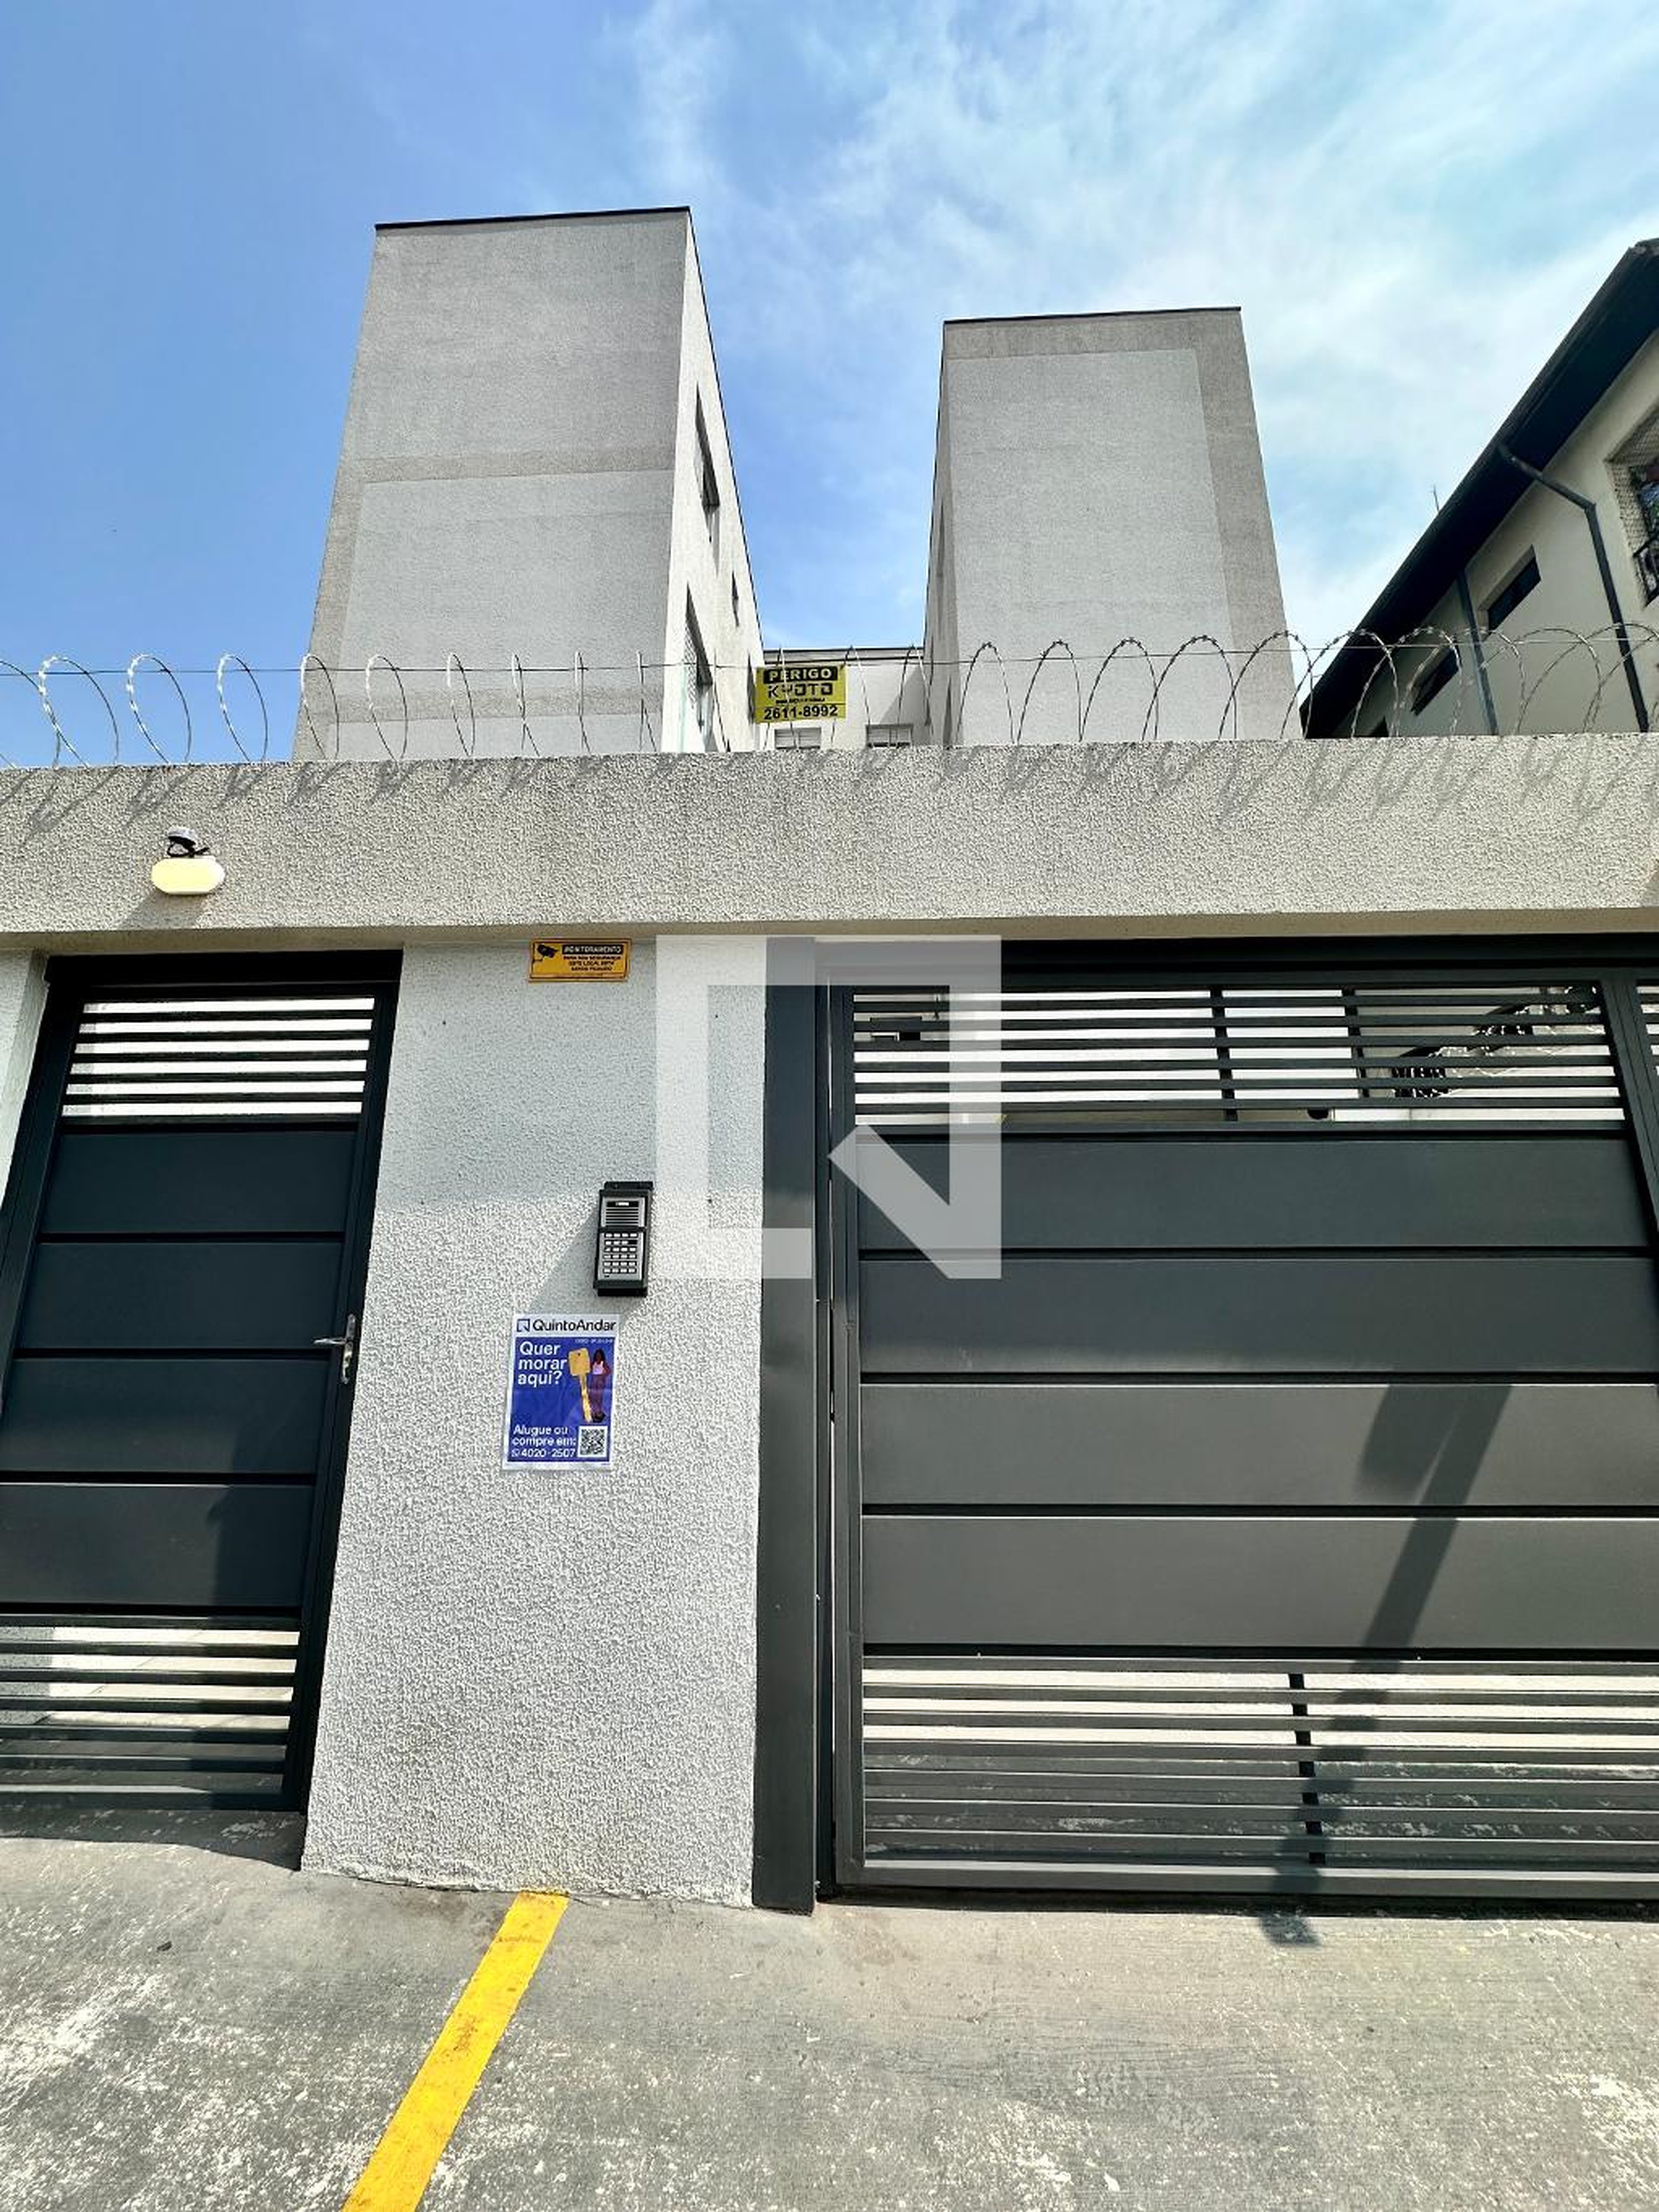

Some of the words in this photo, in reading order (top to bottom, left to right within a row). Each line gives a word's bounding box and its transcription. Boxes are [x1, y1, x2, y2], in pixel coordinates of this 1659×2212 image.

[769, 668, 832, 681] PERIGO
[769, 683, 833, 698] KYOTO
[764, 705, 838, 720] 2611-8992
[533, 1319, 616, 1331] QuintoAndar
[520, 1341, 561, 1355] Quer
[518, 1359, 567, 1370] morar
[518, 1371, 562, 1388] aqui?
[513, 1424, 552, 1436] Alugue
[512, 1437, 554, 1447] compre
[556, 1437, 576, 1446] em:
